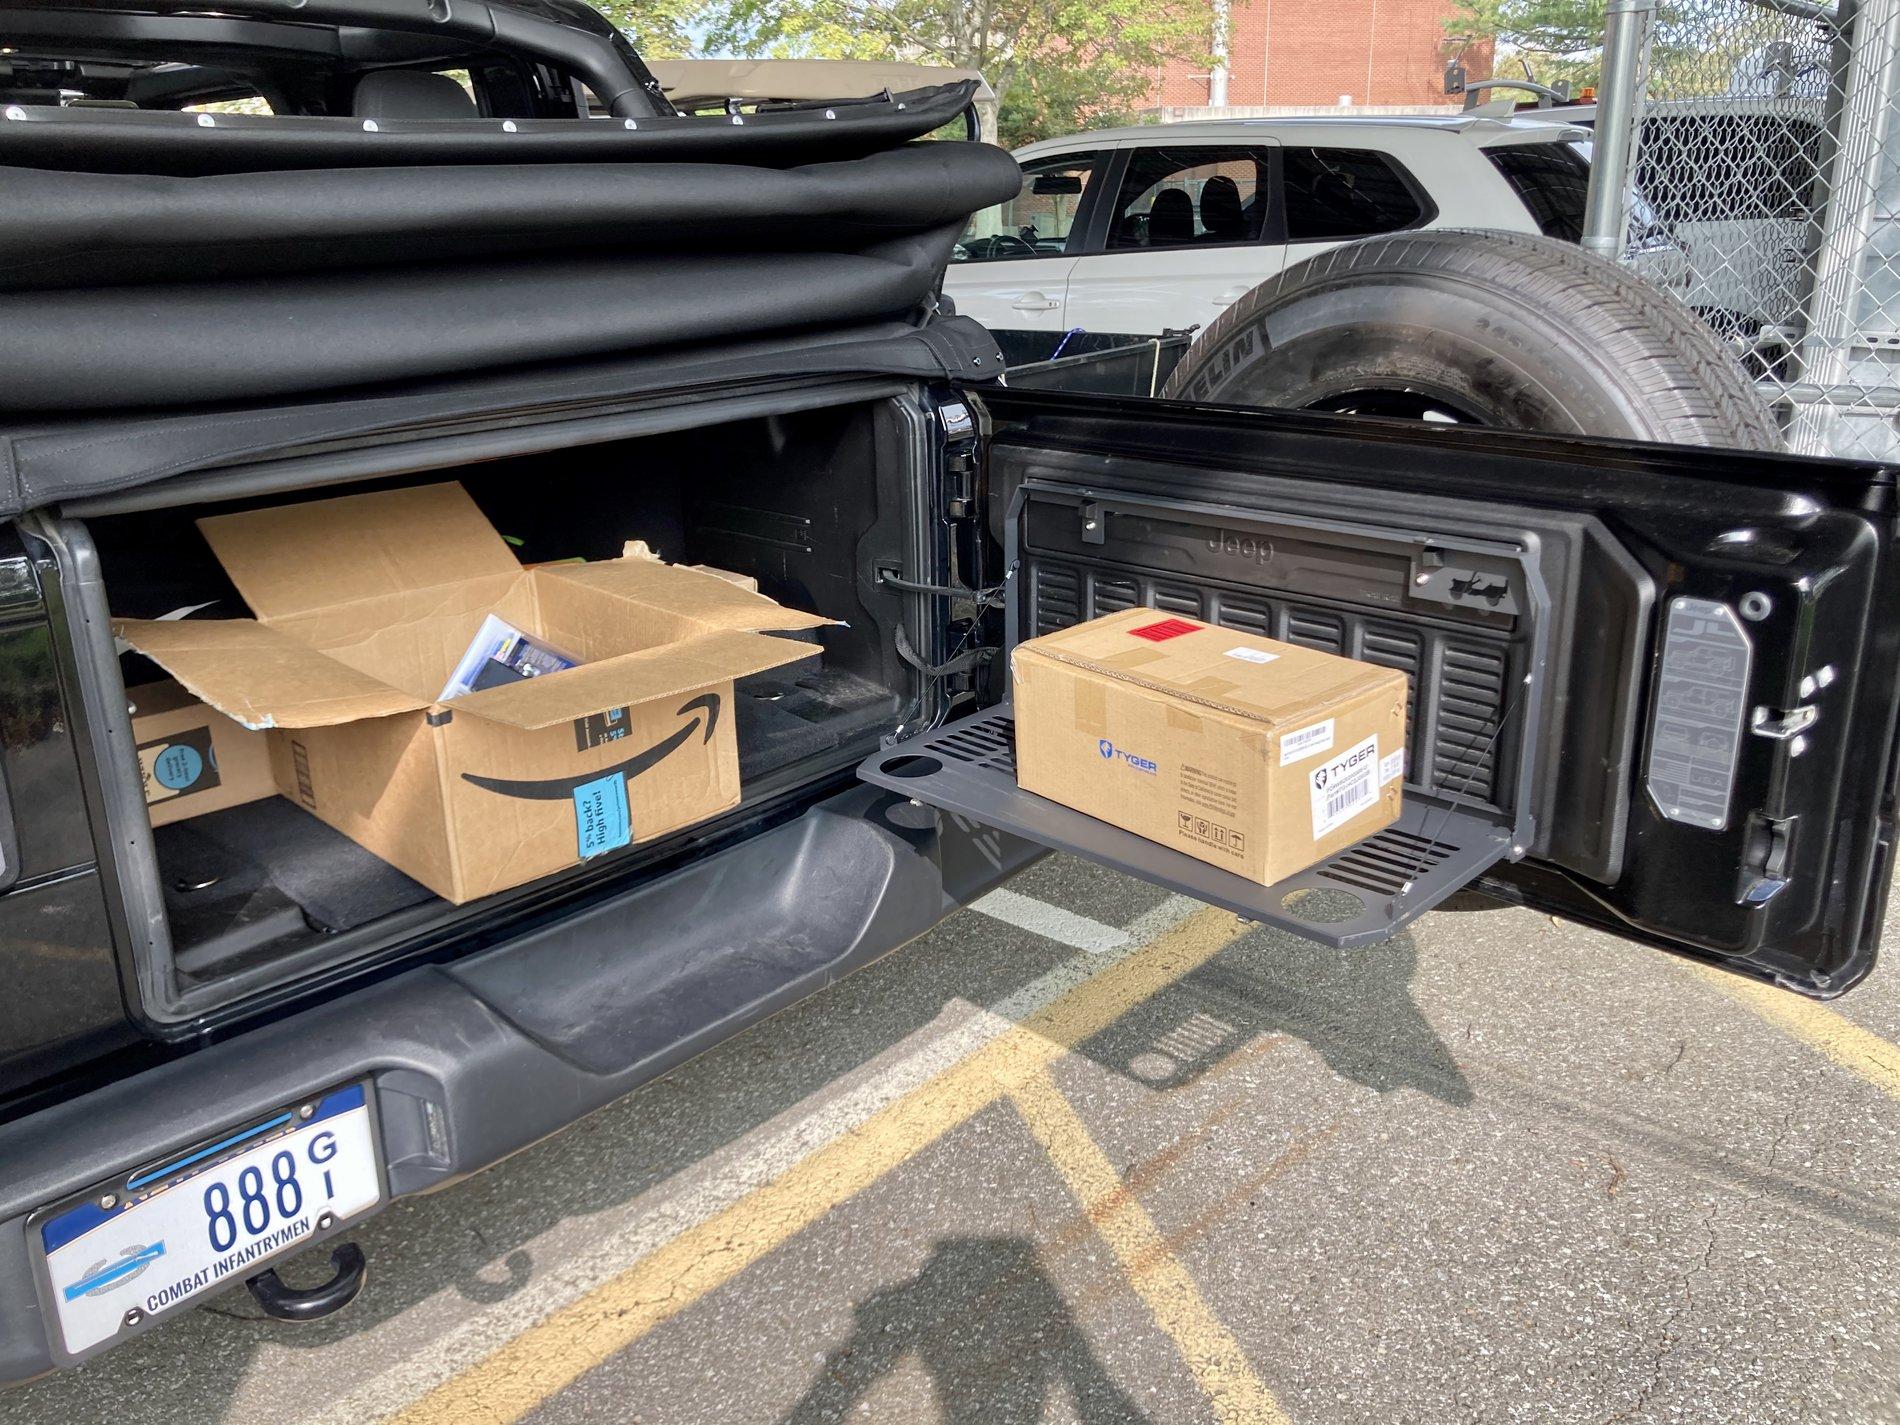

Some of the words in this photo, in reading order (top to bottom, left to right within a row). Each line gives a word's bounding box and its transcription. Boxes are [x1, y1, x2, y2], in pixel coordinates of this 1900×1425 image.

[1208, 530, 1274, 566] Jeep
[1114, 749, 1157, 772] TYGER
[1331, 743, 1375, 777] TYGER
[583, 799, 595, 834] back?
[592, 790, 604, 818] five!
[594, 819, 606, 846] High
[1178, 828, 1198, 842] Please
[1197, 832, 1218, 850] handle
[1230, 849, 1245, 860] care
[203, 1149, 303, 1253] 888
[146, 1266, 210, 1312] COMBAT
[212, 1216, 311, 1279] INFANTRYMEN
